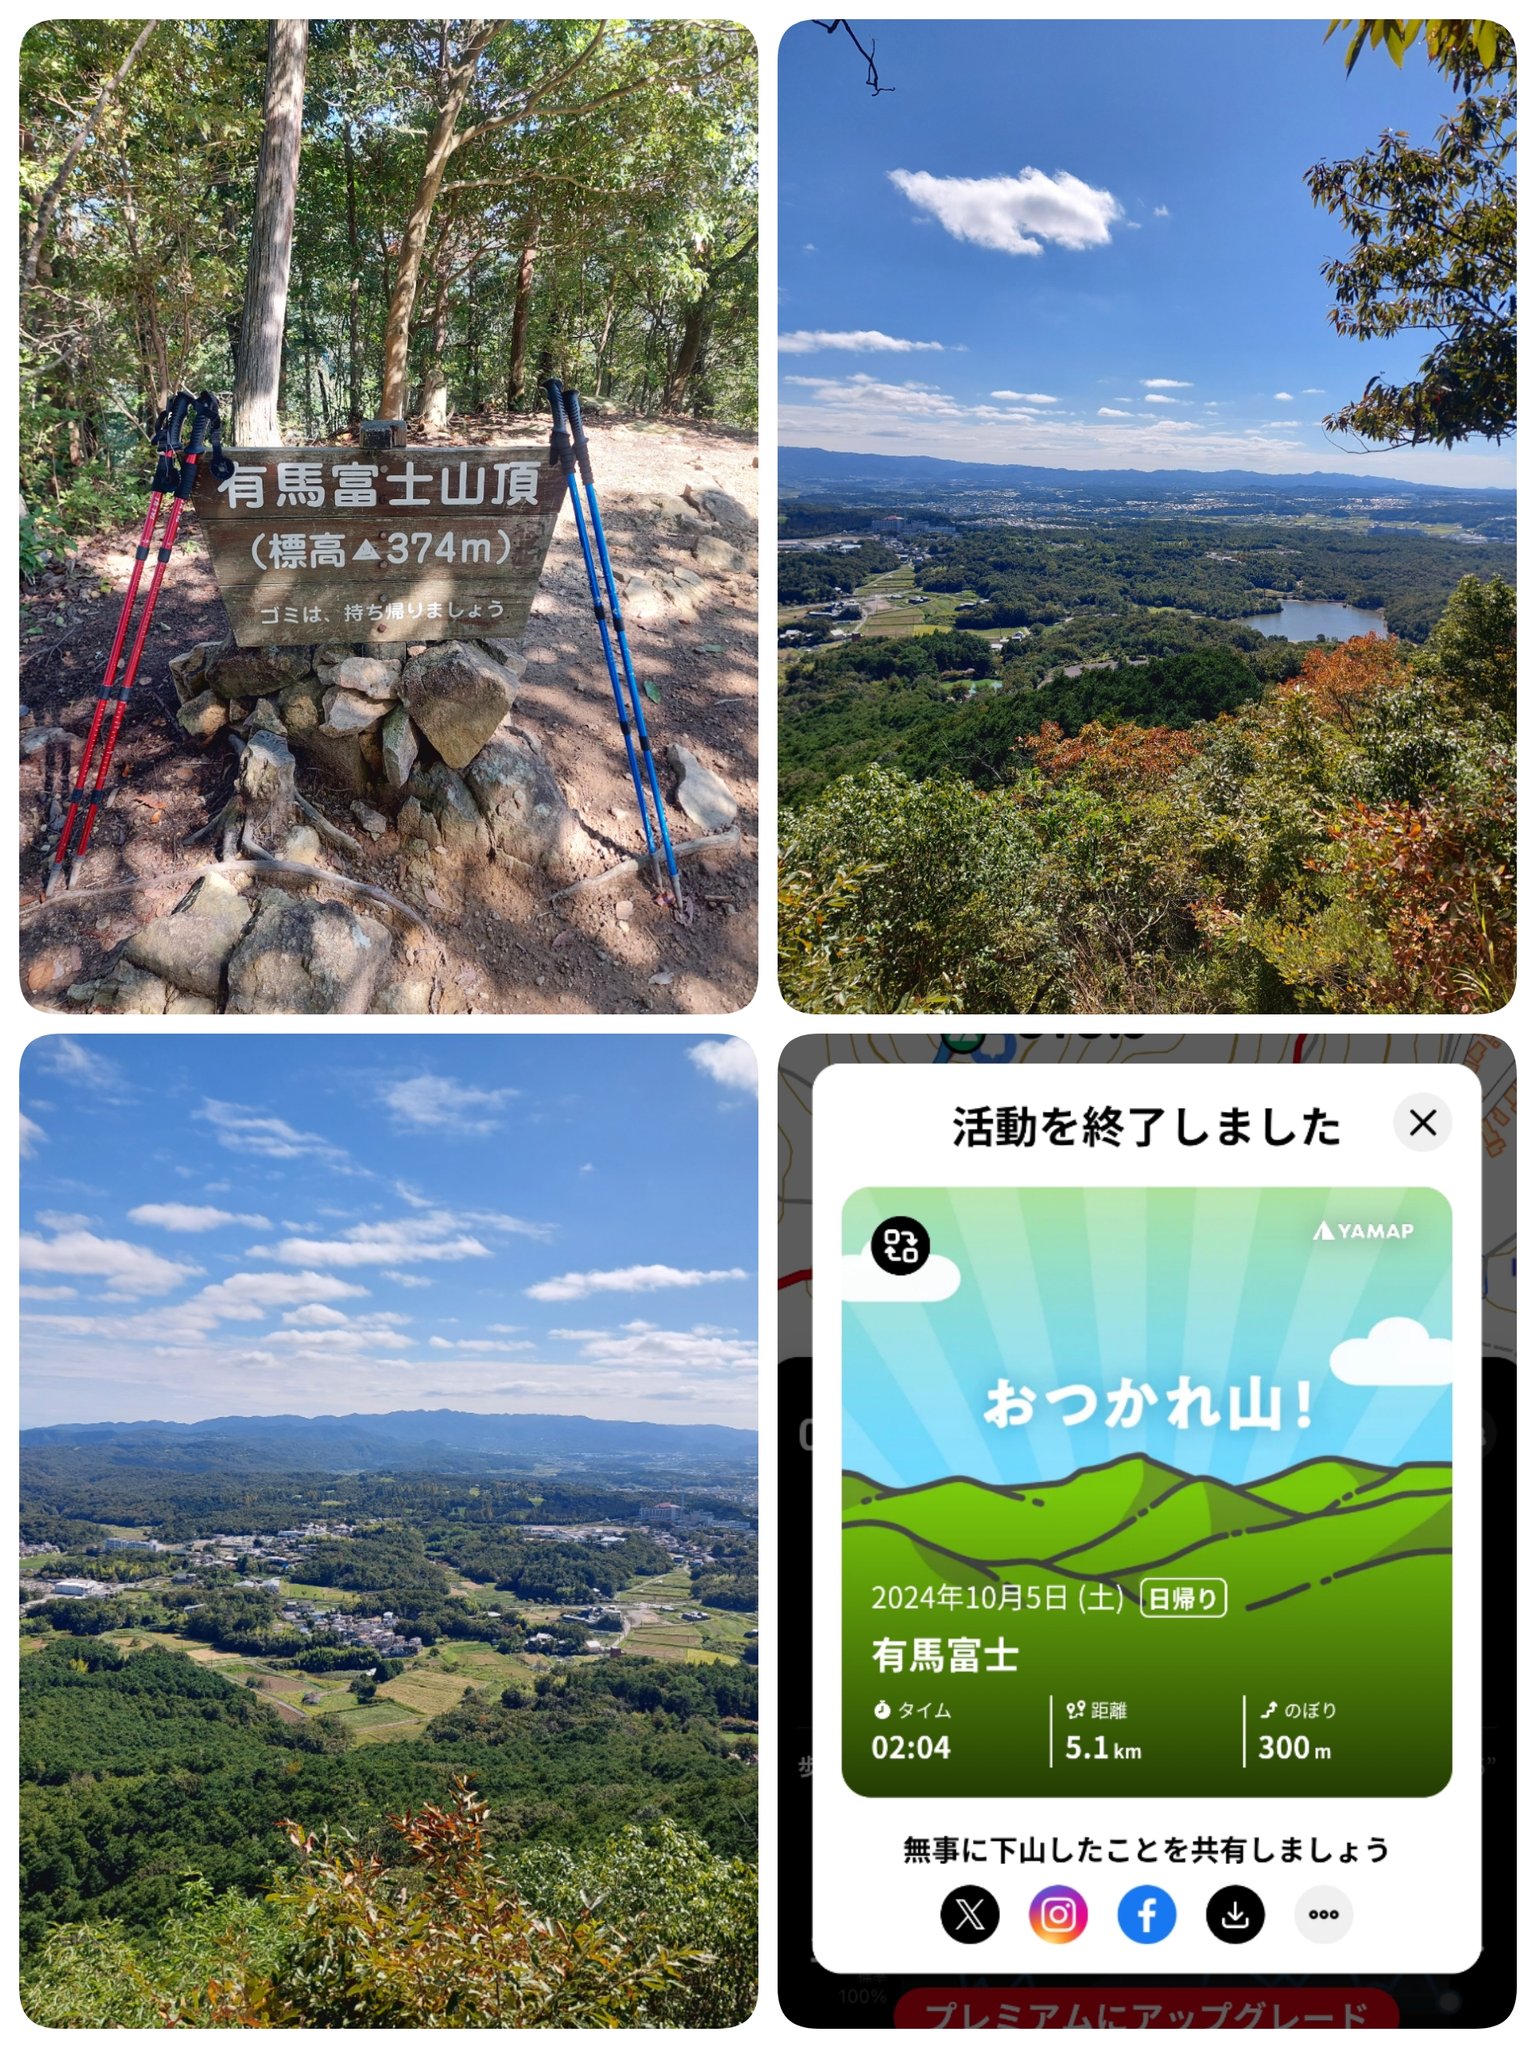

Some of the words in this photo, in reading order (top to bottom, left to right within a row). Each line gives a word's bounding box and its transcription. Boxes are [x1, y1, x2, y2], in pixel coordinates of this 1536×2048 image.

[217, 460, 541, 510] 有馬富士山頂
[260, 601, 505, 625] ゴミは、持ち帰りましょう
[953, 1105, 1340, 1148] 活動を終了しました
[1338, 1223, 1414, 1239] YAMAP
[983, 1375, 1312, 1431] おつかれ山!
[871, 1583, 1067, 1612] 2024年10月5日
[1079, 1583, 1124, 1614] (土)
[1149, 1587, 1217, 1612] 日帰り
[872, 1636, 1020, 1673] 有馬富士
[898, 1702, 952, 1719] タイム
[1091, 1702, 1128, 1720] 距離
[1284, 1702, 1337, 1720] のぼり
[871, 1735, 952, 1760] 02:04
[1065, 1735, 1109, 1760] 5.1
[1113, 1737, 1142, 1760] km
[1258, 1735, 1310, 1760] 300
[1314, 1744, 1332, 1760] m
[903, 1835, 1389, 1866] 無事に下山したことを共有しましょう
[925, 2001, 1367, 2029] プレミアムにアップグレード
